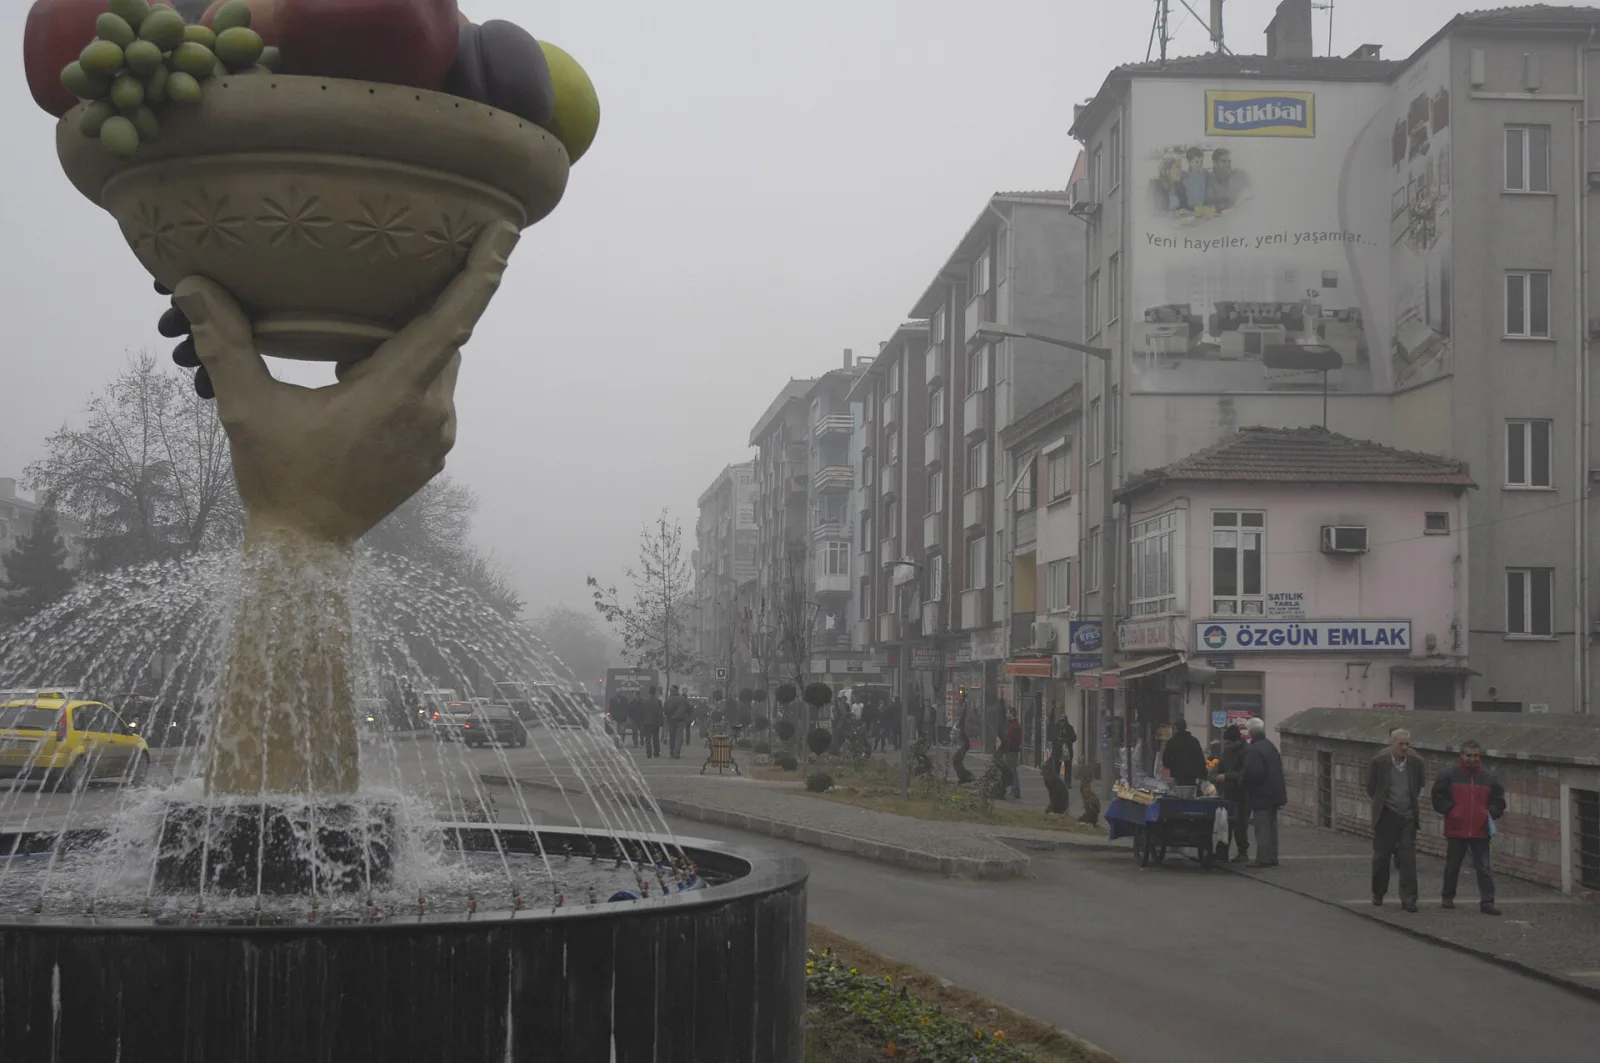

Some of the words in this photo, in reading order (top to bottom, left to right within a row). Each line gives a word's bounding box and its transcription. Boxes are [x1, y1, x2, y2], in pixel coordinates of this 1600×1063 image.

[1217, 101, 1302, 124] istikbal
[1146, 232, 1177, 248] Yeni
[1184, 236, 1249, 252] hayeller,
[1255, 230, 1287, 248] yeni
[1293, 229, 1378, 246] yaşamlar...
[1268, 592, 1304, 601] SATILIK
[1080, 629, 1101, 641] EFES
[1236, 624, 1318, 646] ÖZGÜN
[1328, 628, 1406, 646] EMLAK
